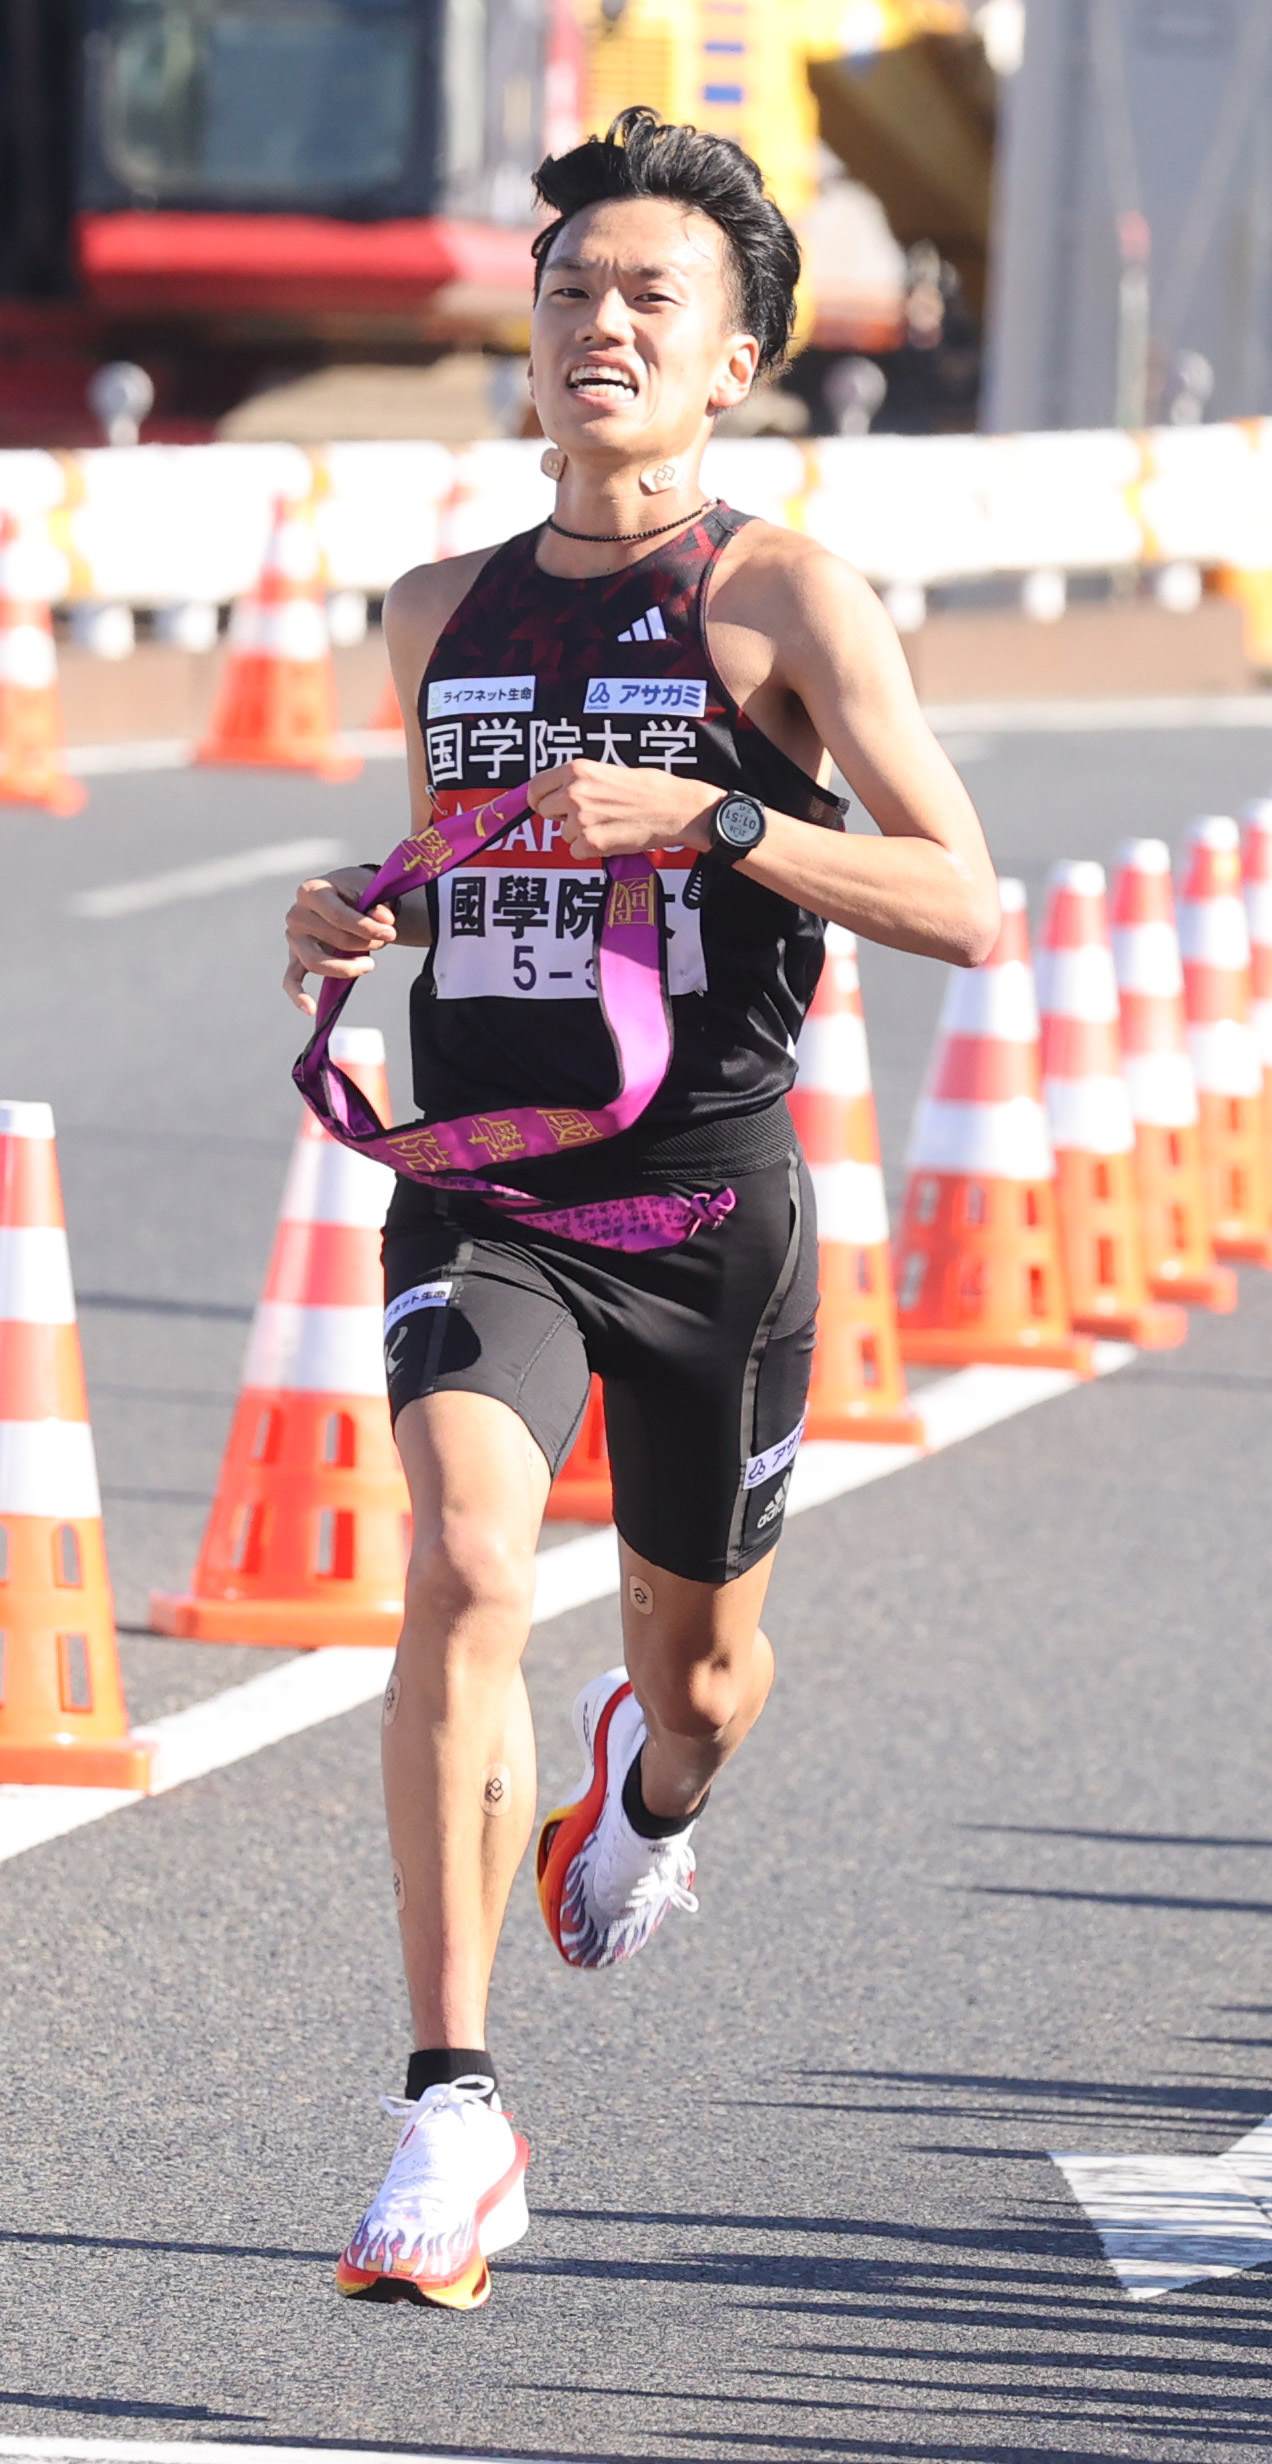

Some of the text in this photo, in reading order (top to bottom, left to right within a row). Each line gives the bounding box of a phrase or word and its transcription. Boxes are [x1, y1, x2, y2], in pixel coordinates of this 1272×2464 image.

[443, 687, 532, 704] ライフネット生命
[619, 684, 701, 708] アサガミ
[426, 717, 698, 786] 国学院大学
